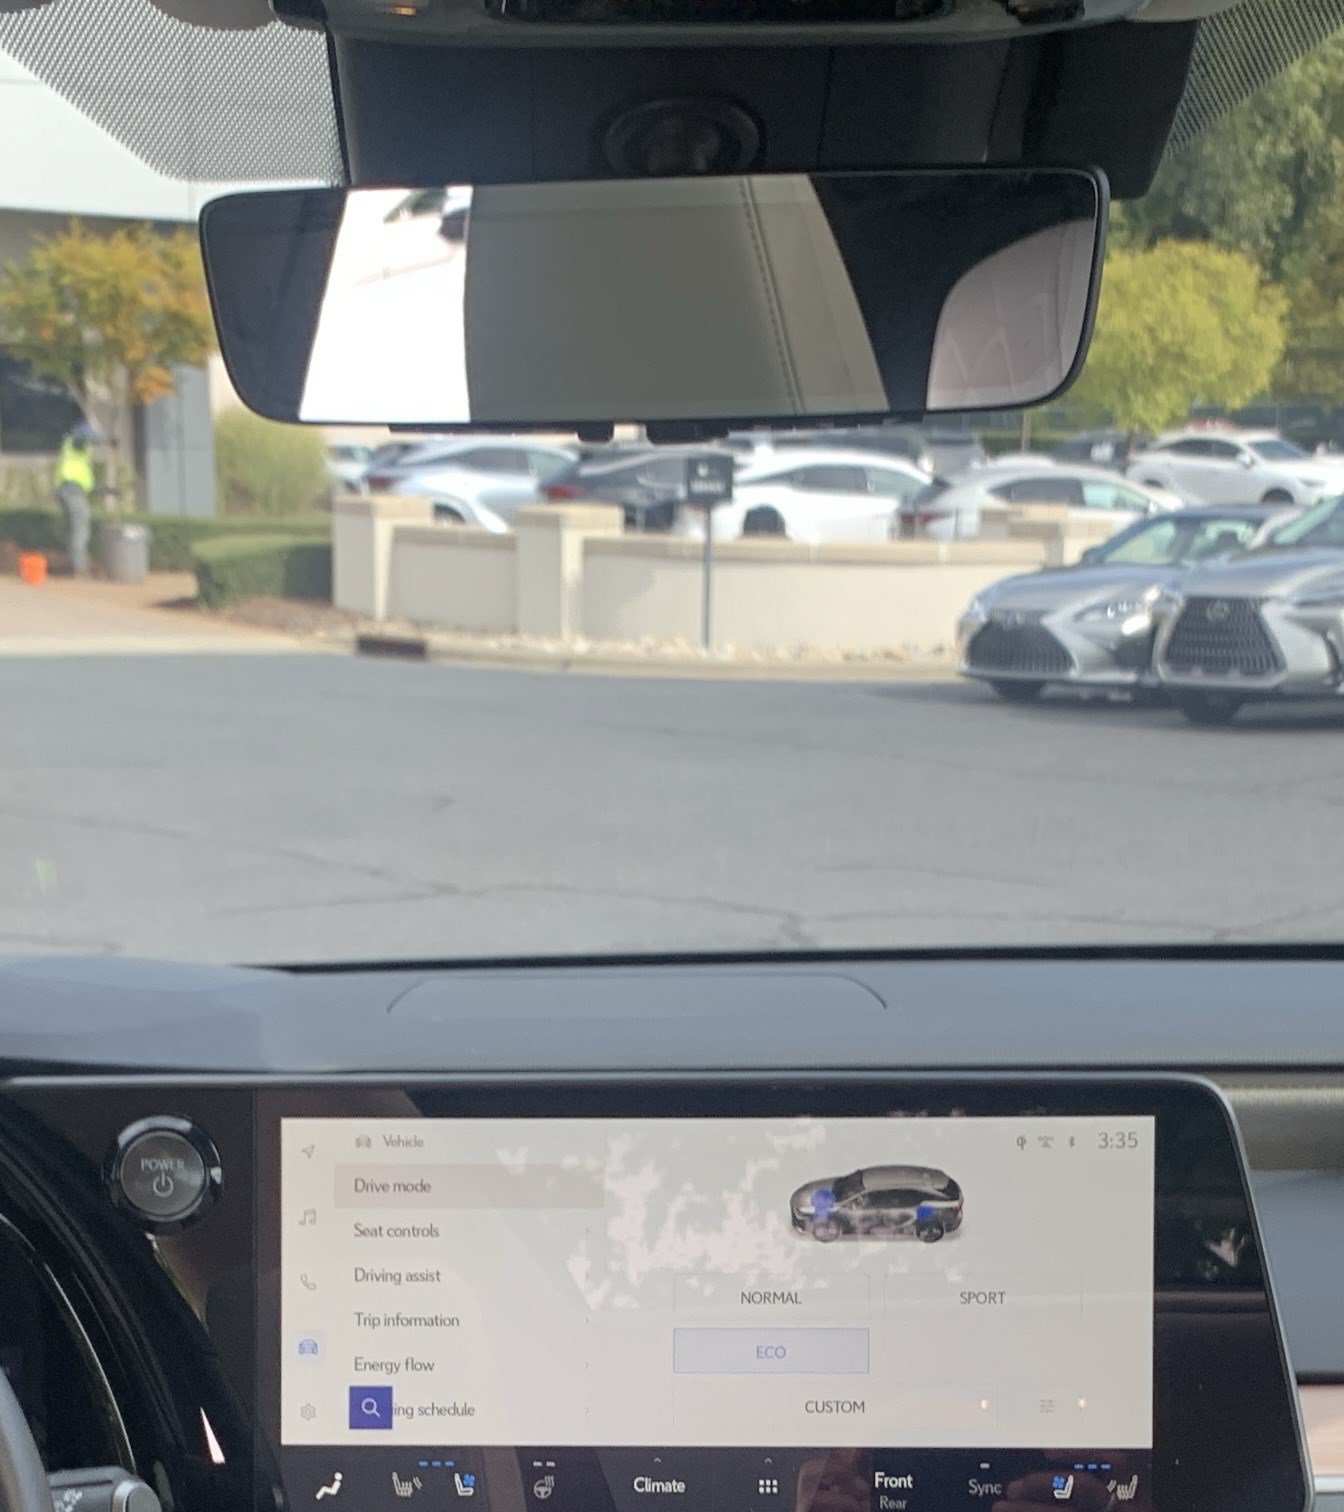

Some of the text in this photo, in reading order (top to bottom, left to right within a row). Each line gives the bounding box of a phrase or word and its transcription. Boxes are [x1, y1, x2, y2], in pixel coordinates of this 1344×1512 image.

[382, 1134, 424, 1148] Vehicle
[1098, 1131, 1138, 1149] 3:35
[354, 1177, 431, 1193] Drive mode
[354, 1222, 440, 1238] Seat controls
[354, 1266, 441, 1286] Driving assist
[740, 1291, 802, 1306] NORMAL
[959, 1291, 1007, 1306] SPORT
[354, 1311, 461, 1330] Trip information
[755, 1345, 787, 1361] ECO
[354, 1356, 435, 1375] Energy flow
[417, 1401, 476, 1417] schedule
[804, 1400, 866, 1415] CUSTOM
[633, 1477, 686, 1494] Climate
[874, 1472, 913, 1490] Front
[968, 1478, 1002, 1497] Sync
[879, 1496, 908, 1511] Rear
